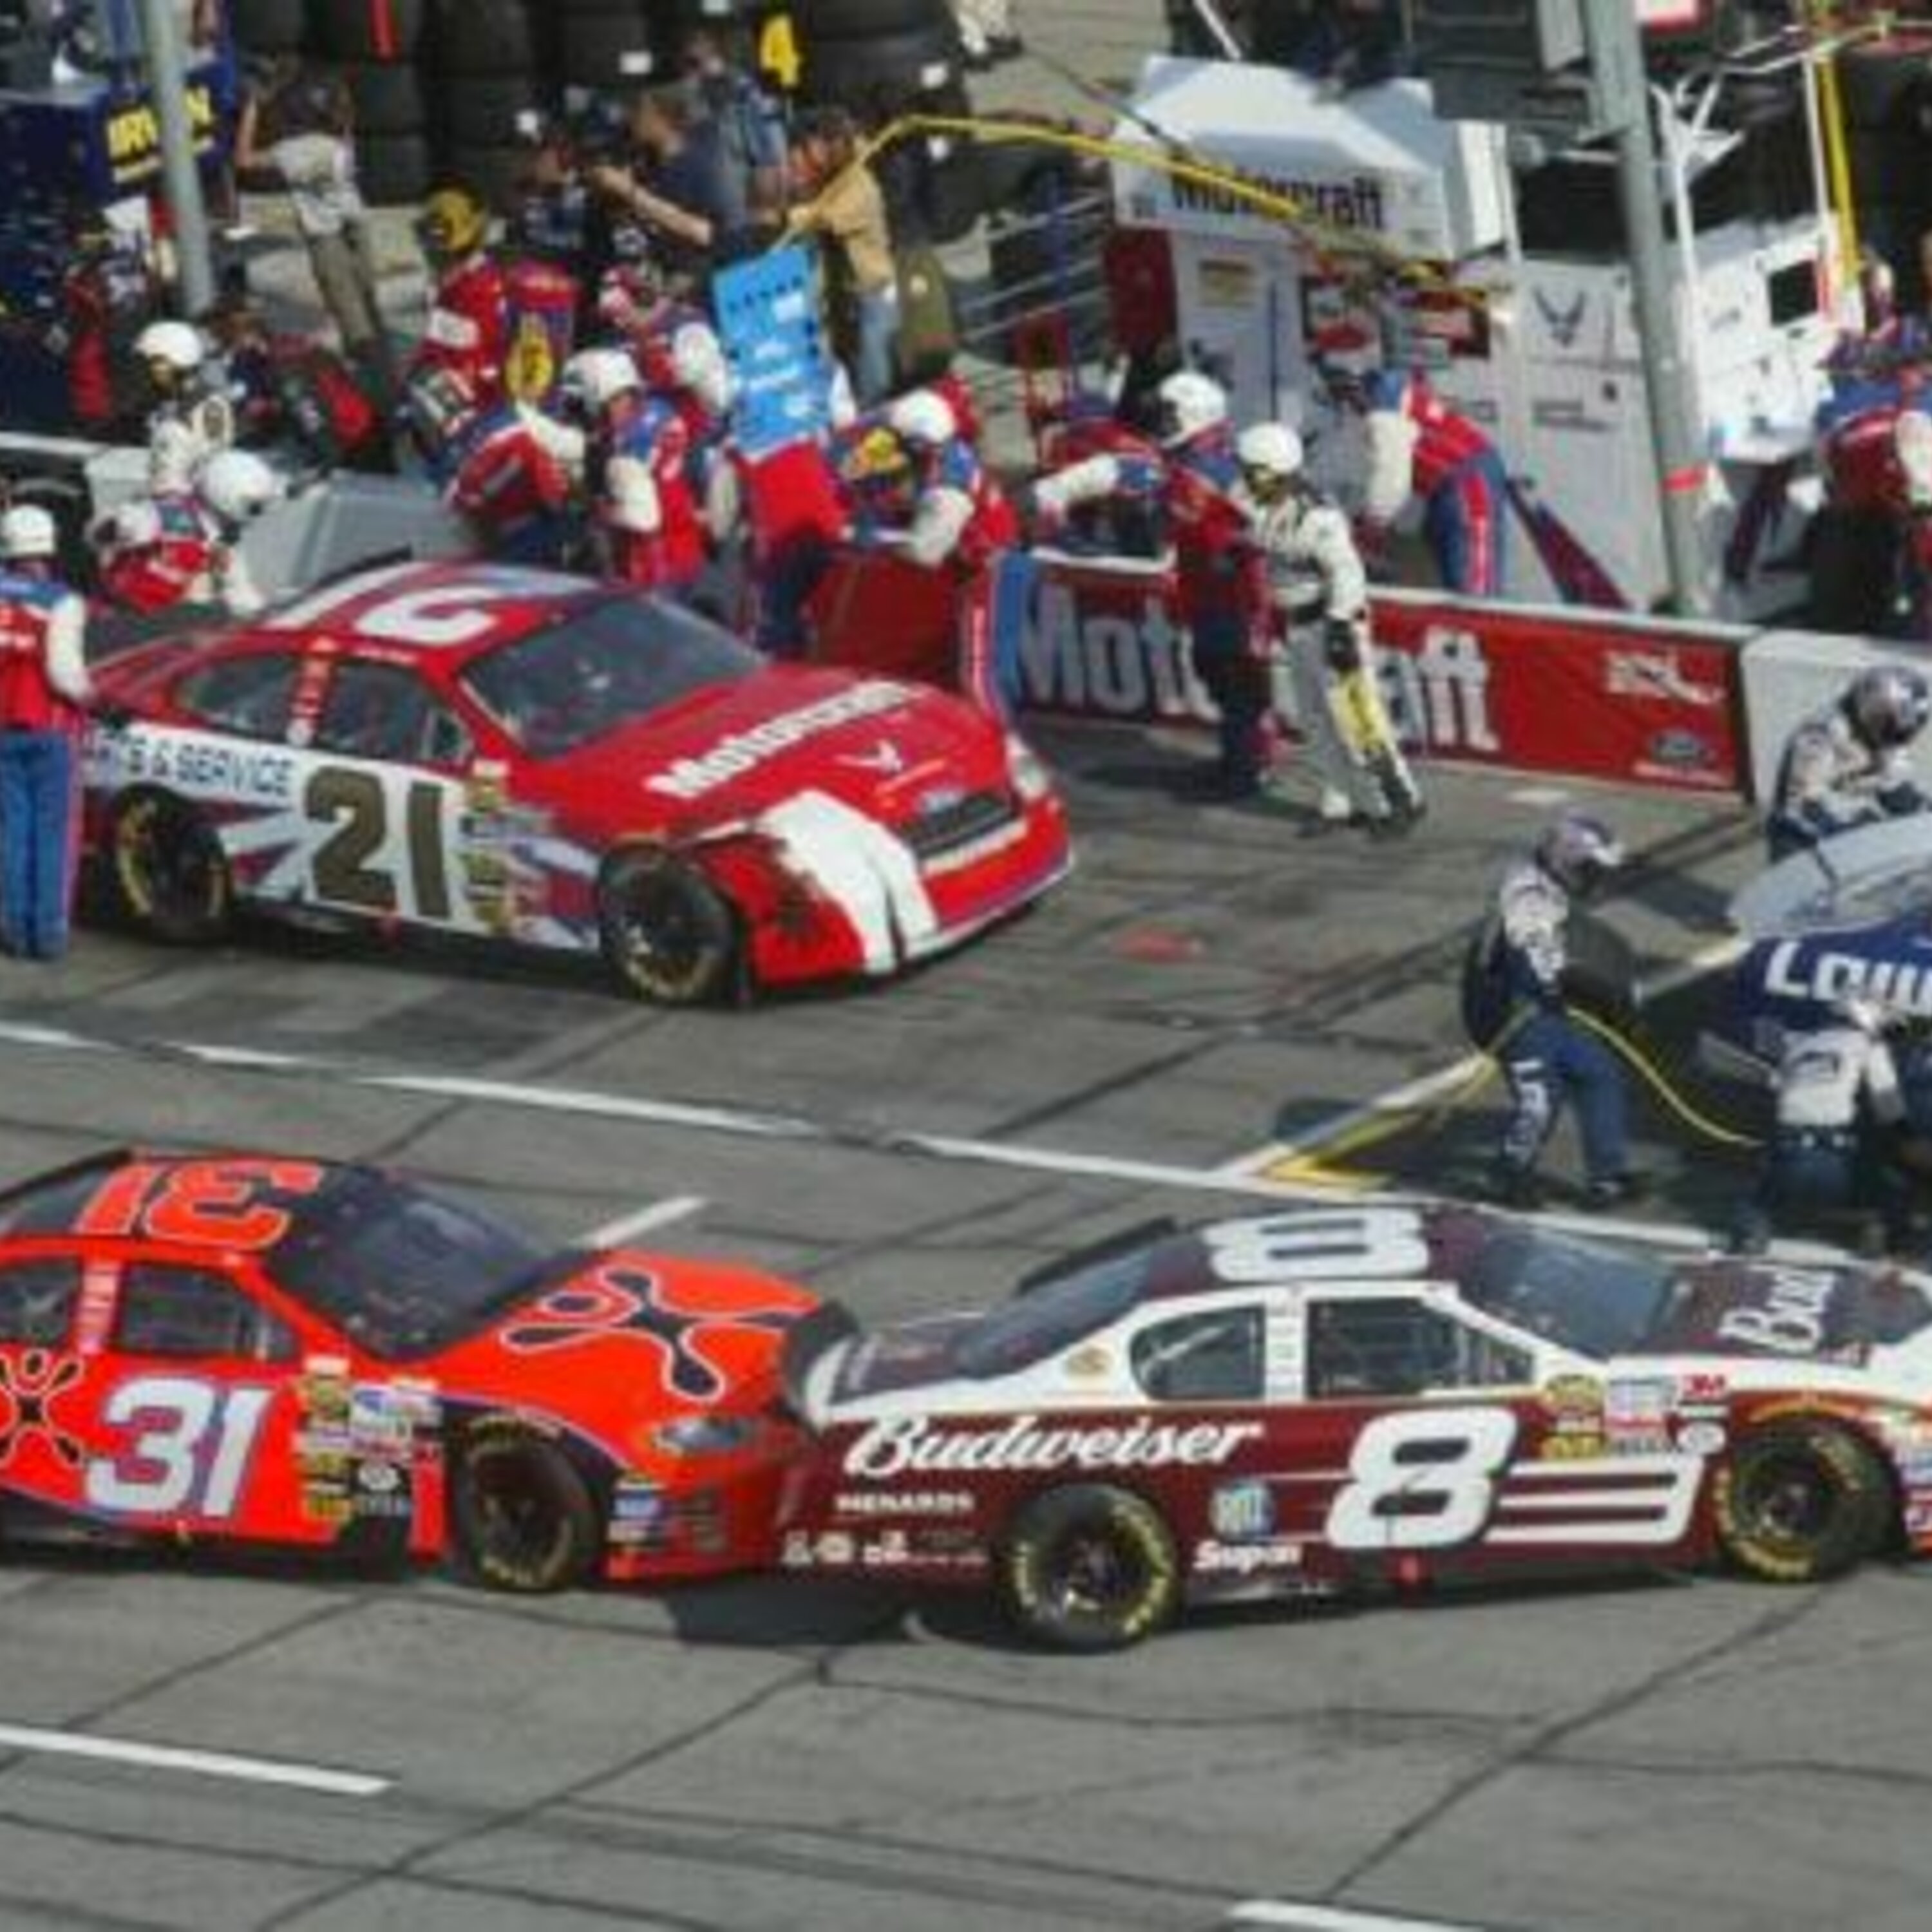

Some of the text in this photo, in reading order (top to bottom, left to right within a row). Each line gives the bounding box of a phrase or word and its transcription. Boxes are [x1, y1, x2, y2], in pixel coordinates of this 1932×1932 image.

[305, 764, 451, 918] 21
[85, 1376, 276, 1519] 31
[842, 1410, 1265, 1477] Budweiser
[1325, 1408, 1519, 1548] 8
